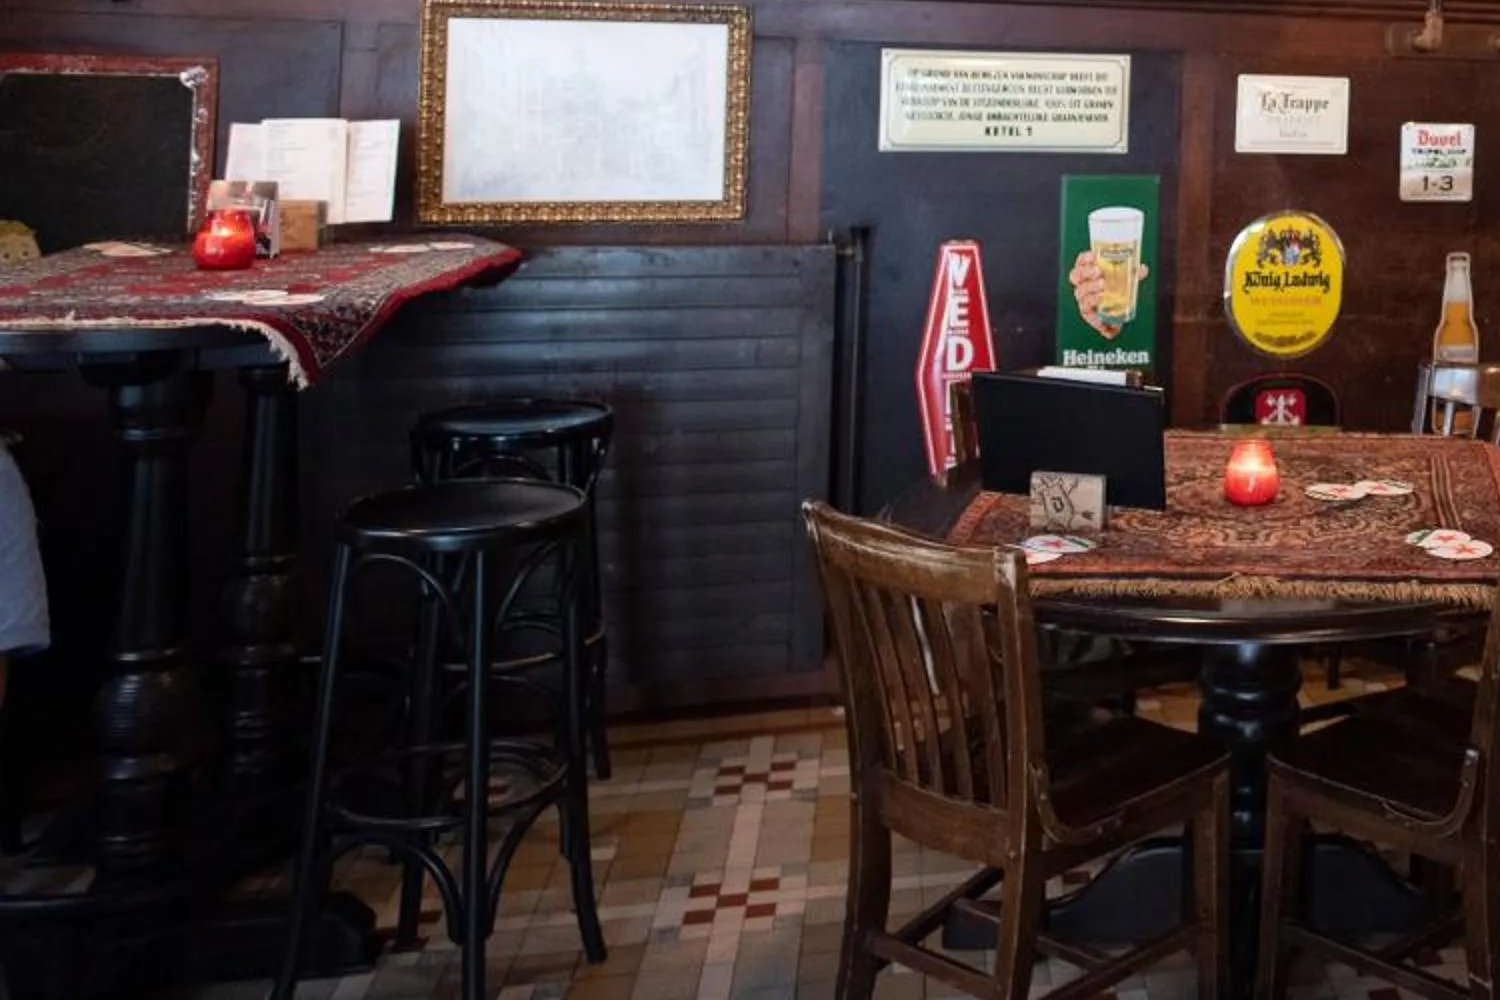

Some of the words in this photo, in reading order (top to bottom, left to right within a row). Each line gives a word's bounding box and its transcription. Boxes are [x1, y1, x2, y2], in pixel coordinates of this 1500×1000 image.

[1278, 91, 1330, 113] Trappe
[1417, 130, 1461, 147] Duvel
[1062, 347, 1150, 367] Heineken
